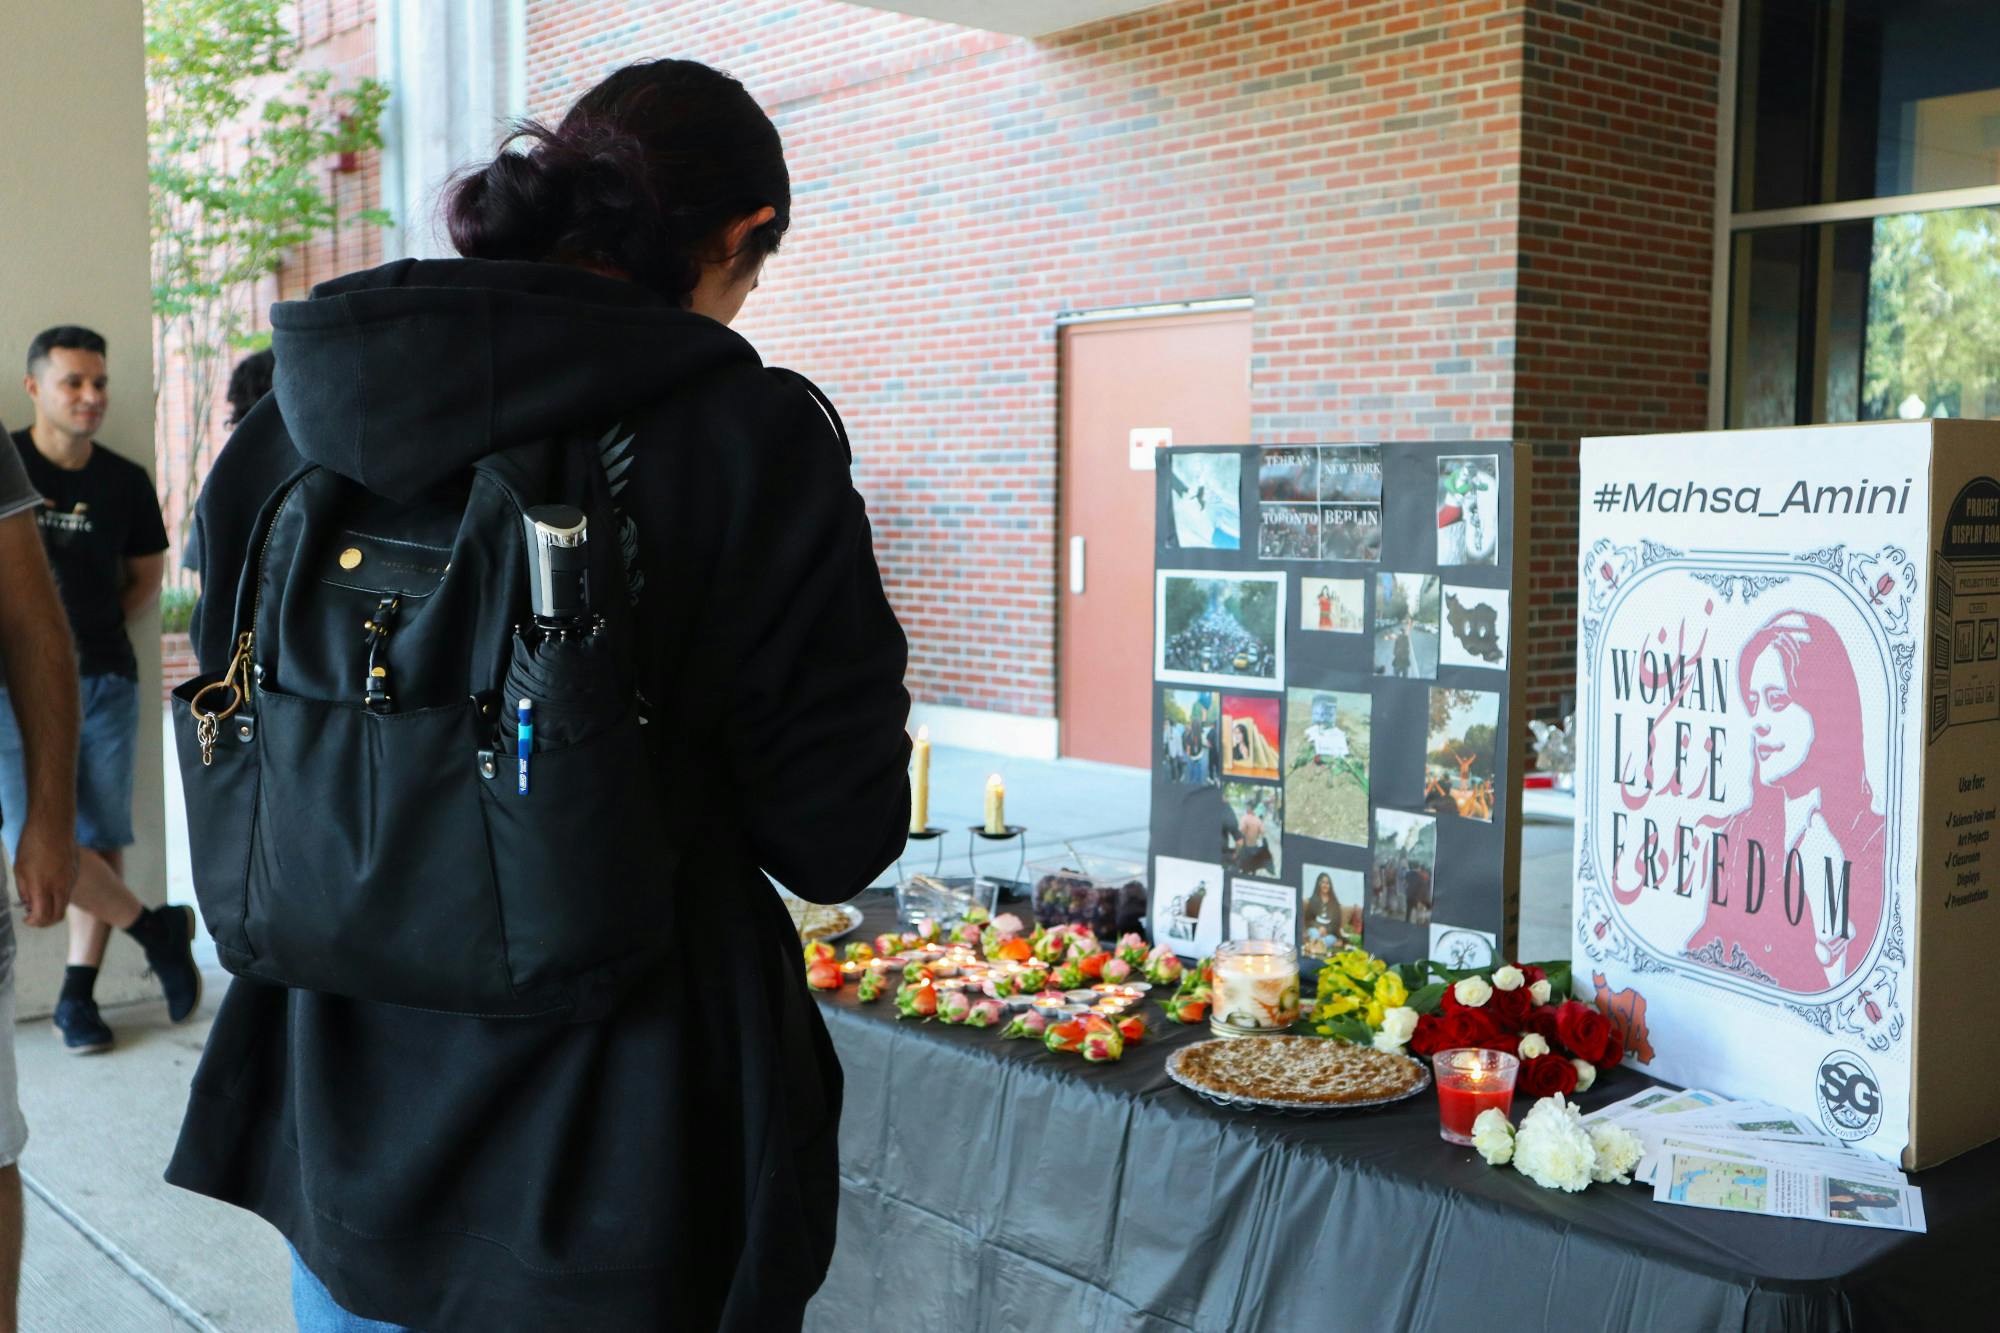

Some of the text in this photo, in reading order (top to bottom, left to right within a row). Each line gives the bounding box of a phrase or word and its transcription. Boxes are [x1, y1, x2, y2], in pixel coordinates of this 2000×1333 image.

[1325, 462, 1382, 474] NEW YORK
[1593, 478, 1913, 517] #Mahsa_Amini
[1966, 497, 2000, 517] PROJECT
[1325, 509, 1378, 525] BERLIN
[1952, 525, 1983, 544] DISPLAY
[1611, 648, 1729, 714] WOMAN
[1613, 712, 1727, 803] LIFE
[1612, 812, 1853, 939] FREEDOM
